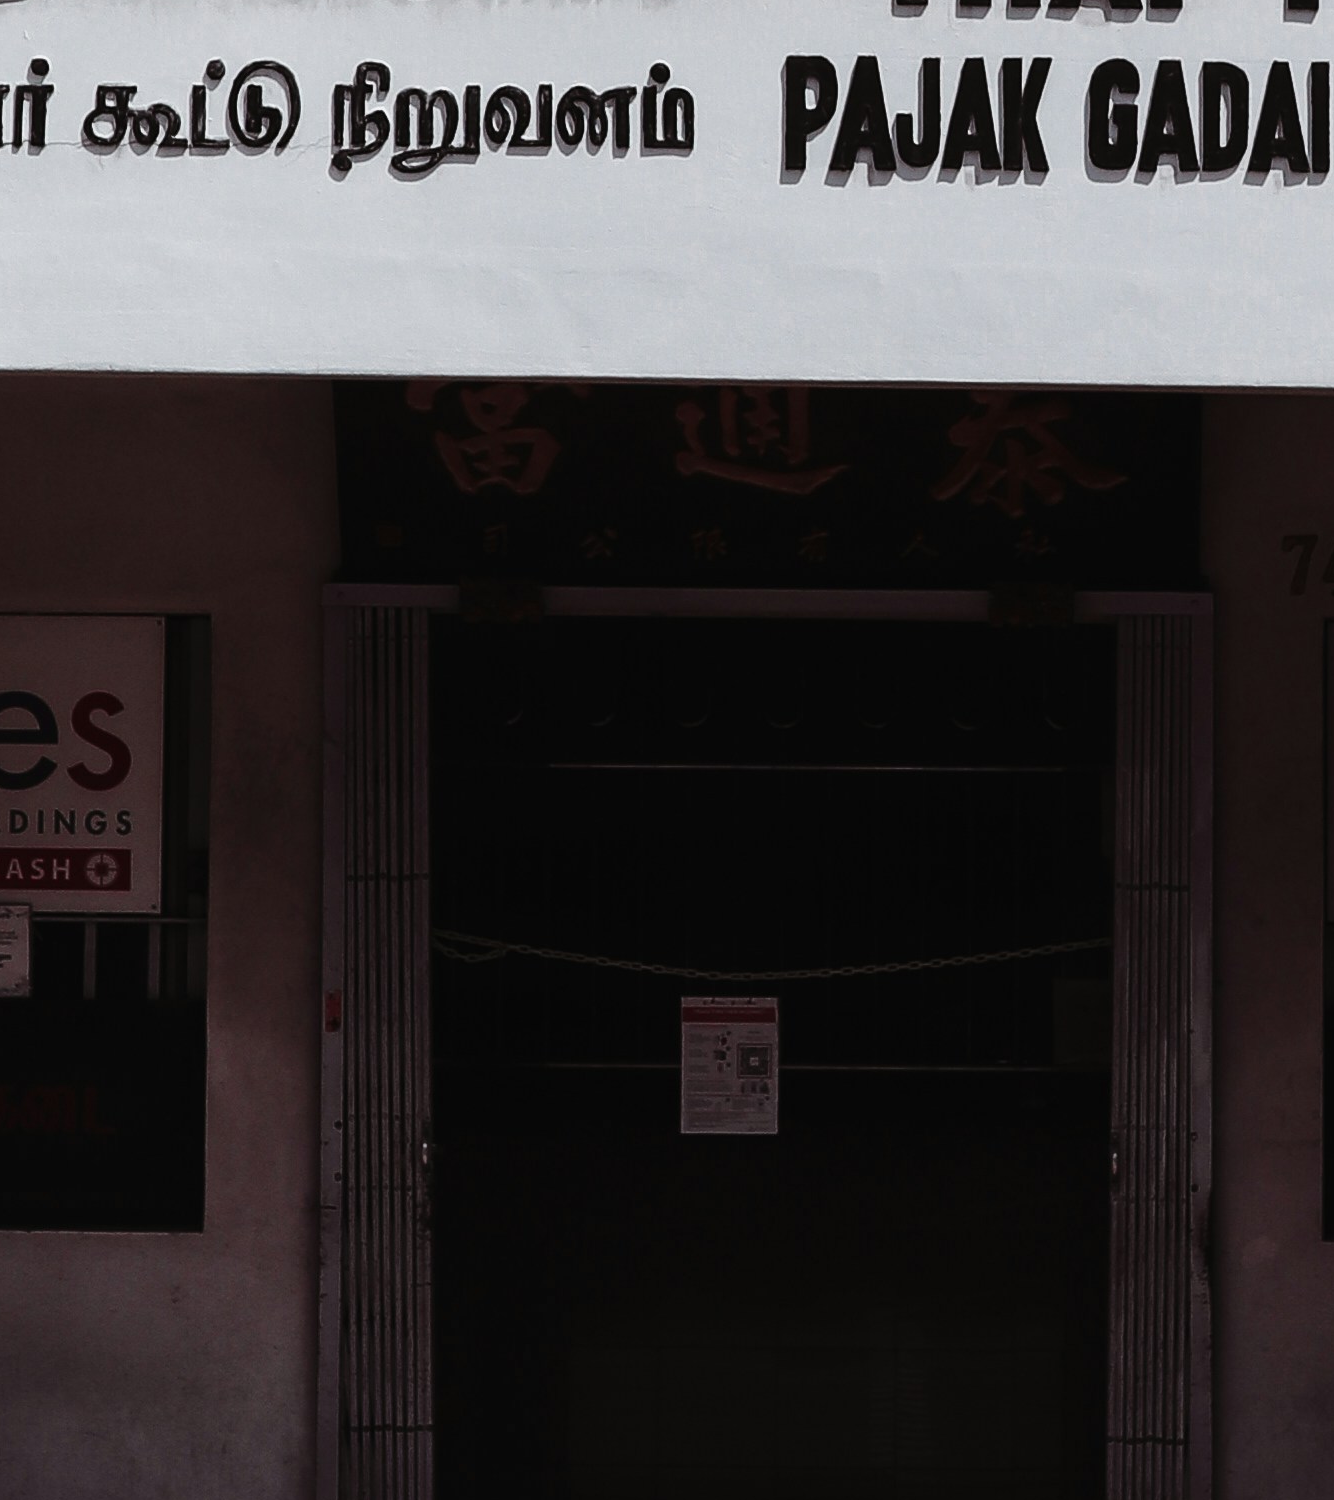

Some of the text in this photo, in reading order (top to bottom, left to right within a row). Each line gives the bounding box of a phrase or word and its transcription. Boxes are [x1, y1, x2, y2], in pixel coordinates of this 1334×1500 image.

[84, 60, 300, 152] கூட்டு
[332, 62, 694, 173] நிறுவனம்
[785, 56, 1052, 174] PAJAK
[1088, 59, 1330, 175] GADAI
